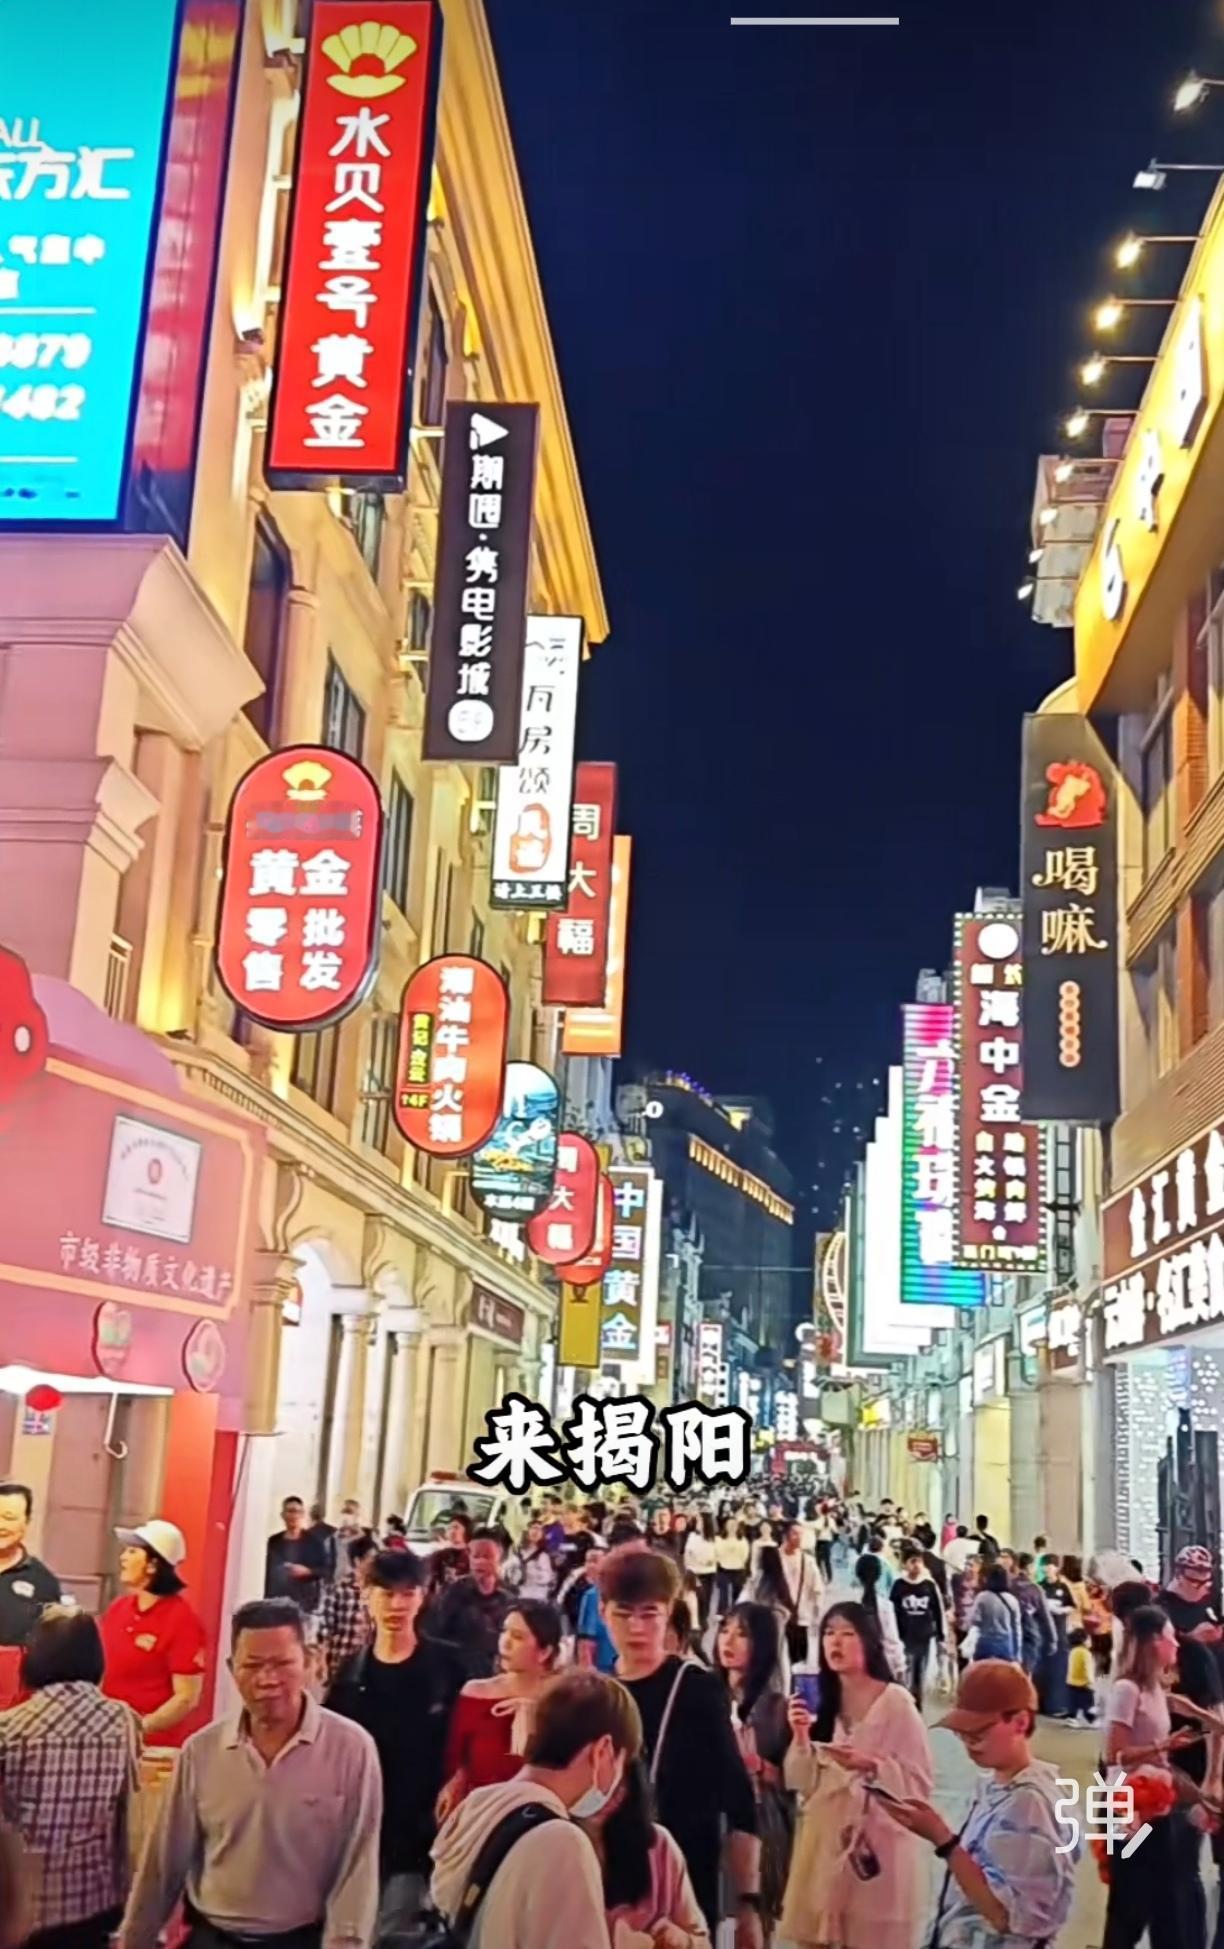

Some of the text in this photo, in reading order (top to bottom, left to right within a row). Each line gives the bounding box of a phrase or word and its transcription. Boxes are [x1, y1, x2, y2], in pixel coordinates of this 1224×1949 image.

[303, 106, 391, 448] 水贝壹号黄金
[248, 849, 351, 896] 黄金
[557, 803, 601, 955] 周大福
[1031, 846, 1108, 955] 喝嘛
[242, 907, 289, 991] 零售
[299, 907, 345, 991] 批发
[60, 1230, 233, 1301] 市级非物质文化遗产
[601, 1181, 645, 1350] 中国黄金
